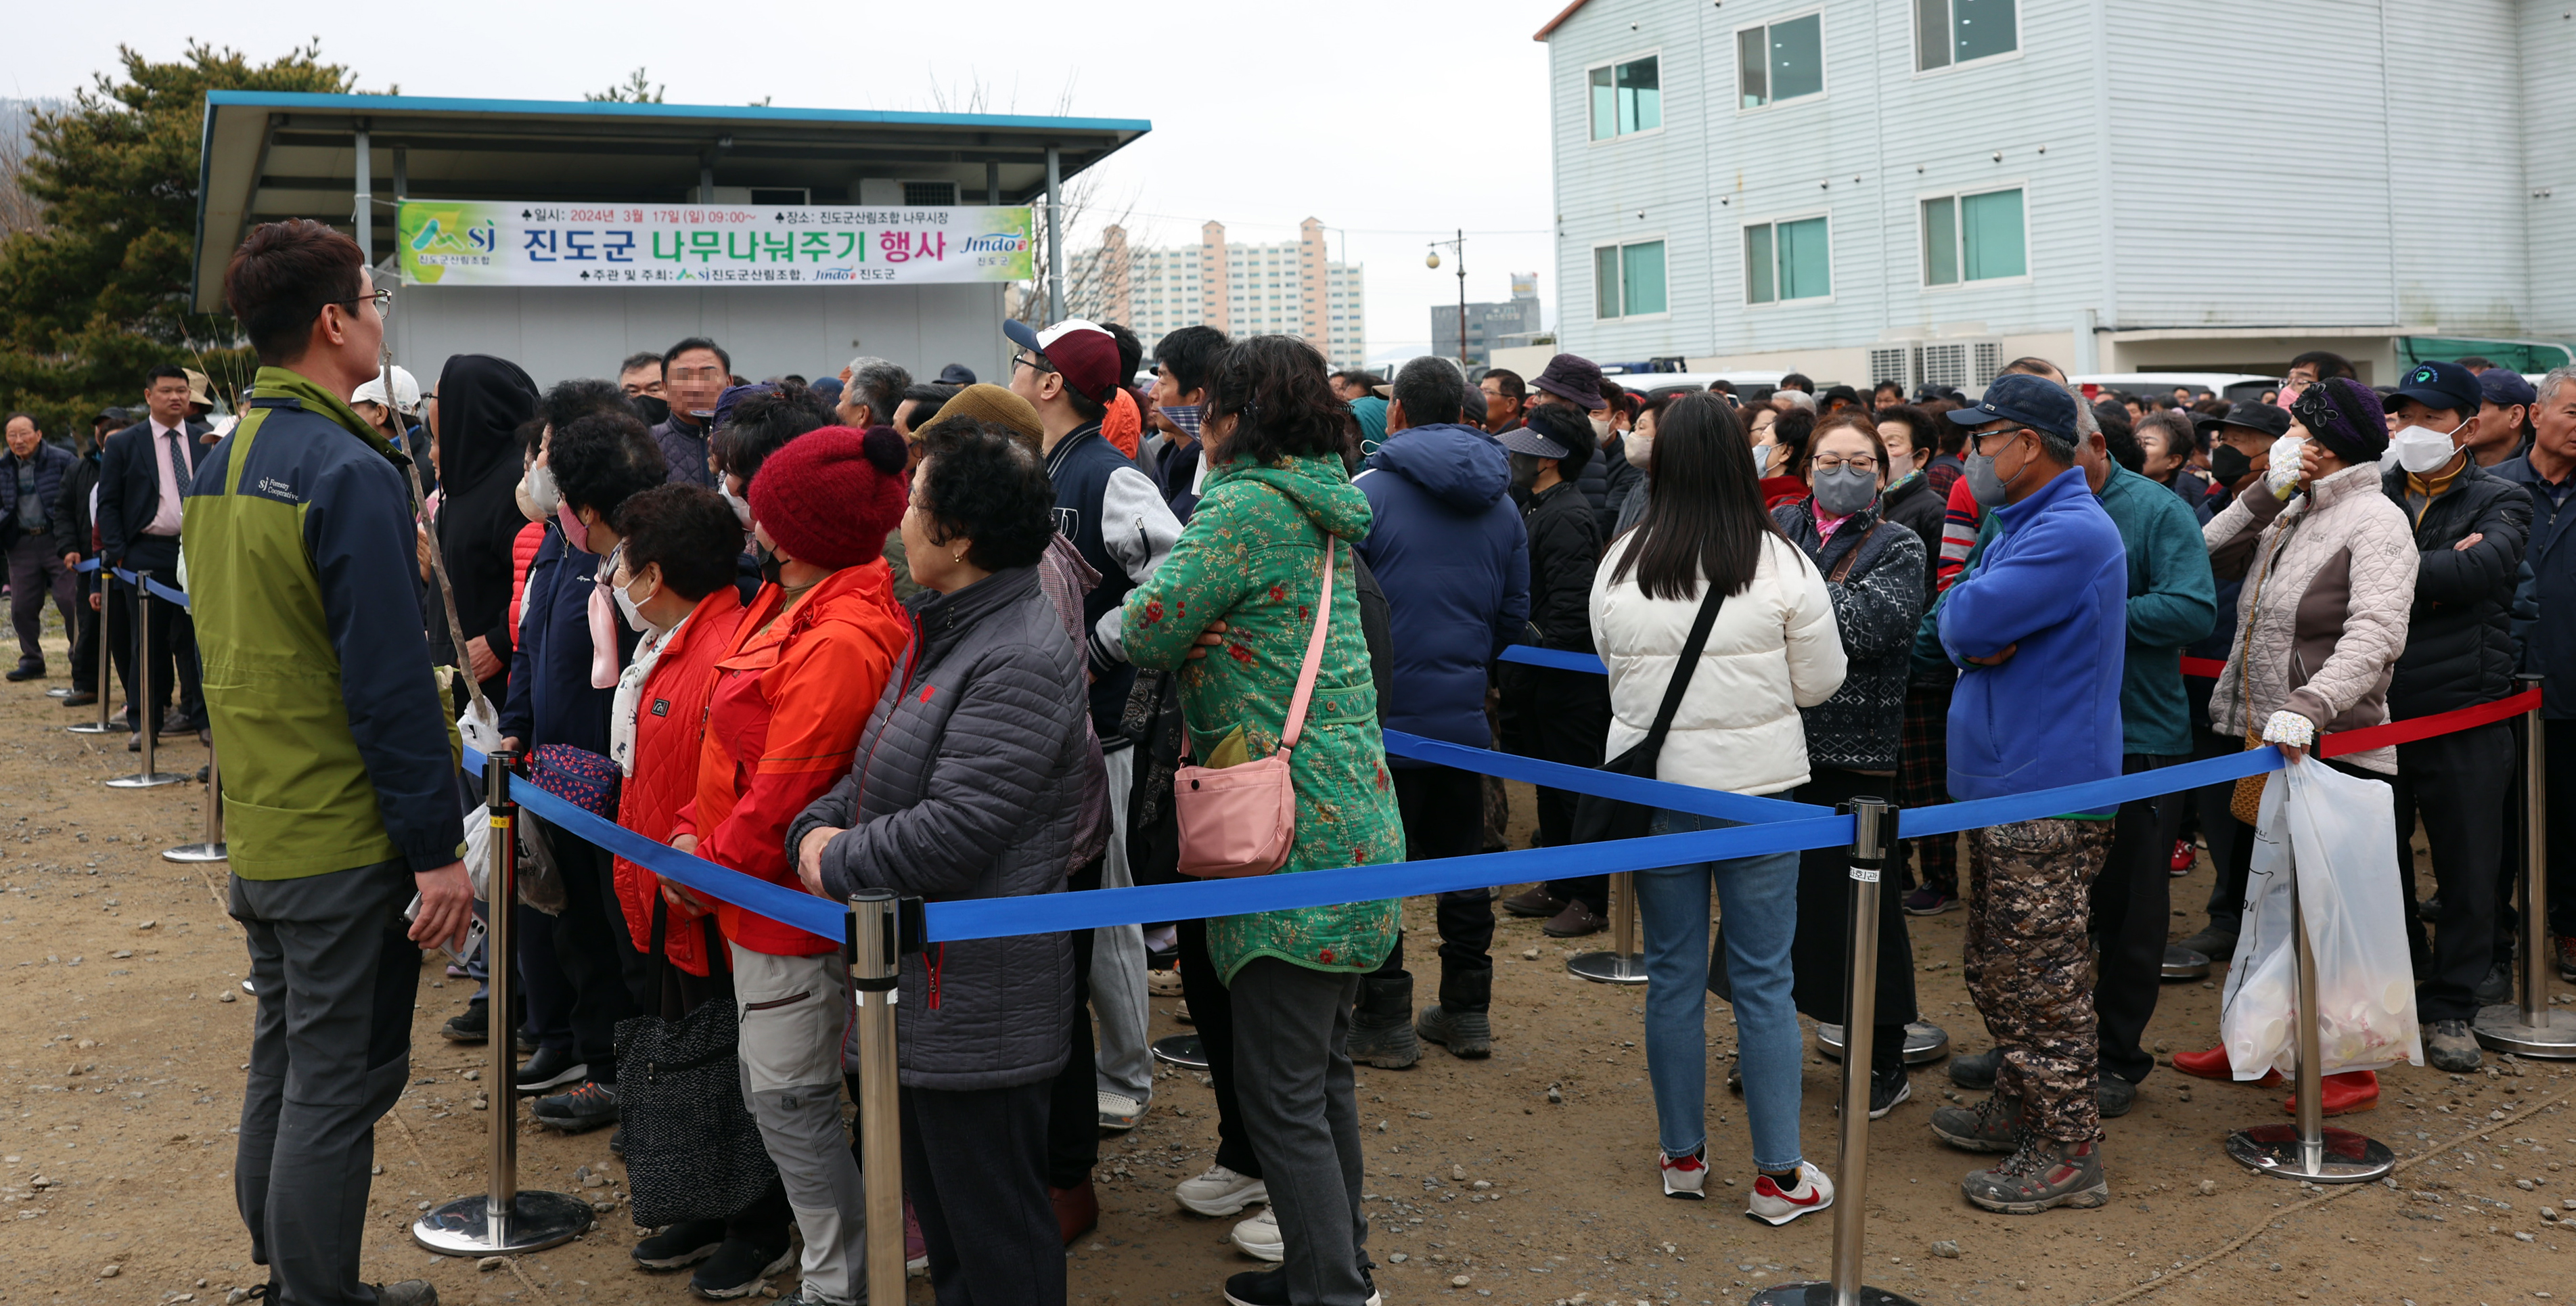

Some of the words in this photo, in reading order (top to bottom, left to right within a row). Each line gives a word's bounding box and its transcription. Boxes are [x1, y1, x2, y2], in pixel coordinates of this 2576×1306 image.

[535, 208, 564, 222] 일시:
[570, 209, 614, 223] 2024년
[623, 209, 643, 223] 3월
[653, 210, 679, 223] 17일
[786, 211, 815, 225] 장소:
[820, 211, 899, 225] 진도군산림조합
[903, 211, 949, 225] 나무시장
[524, 229, 635, 262] 진도군
[652, 230, 865, 263] 나무나눠주기
[879, 231, 946, 263] 행사
[959, 236, 1016, 254] Jindo
[420, 254, 490, 265] 진도군산림조합
[978, 256, 1008, 267] 진도군
[593, 269, 618, 281] 주관
[625, 270, 635, 281] 및
[641, 269, 673, 281] 주최:
[812, 269, 849, 281] Jindo
[859, 269, 895, 280] 진도군
[269, 478, 290, 491] Forestry
[268, 487, 298, 501] Cooperative
